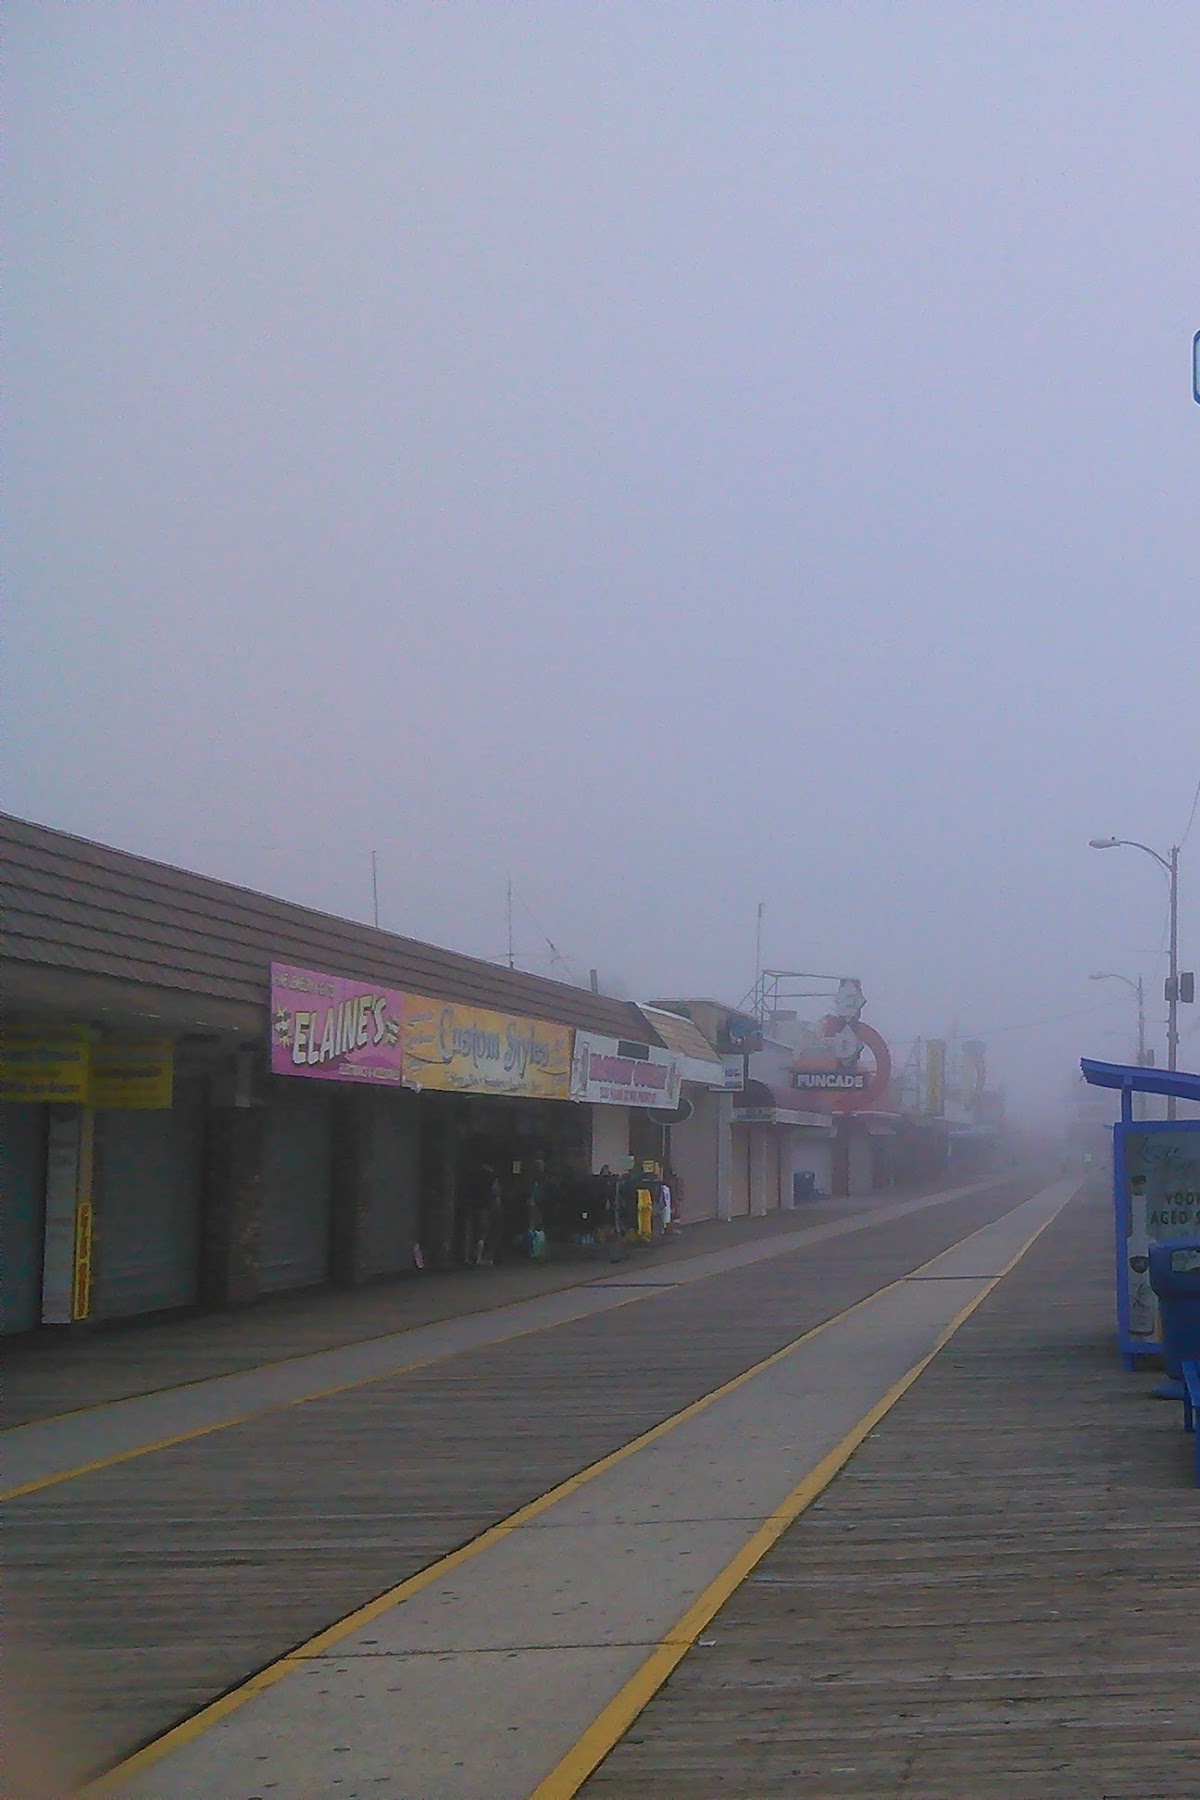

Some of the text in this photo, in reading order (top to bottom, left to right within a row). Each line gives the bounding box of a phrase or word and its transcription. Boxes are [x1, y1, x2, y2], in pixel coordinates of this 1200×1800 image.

[292, 994, 387, 1065] ELAINE'S
[797, 1074, 864, 1088] FUNCADE
[1151, 1210, 1187, 1225] AGED
